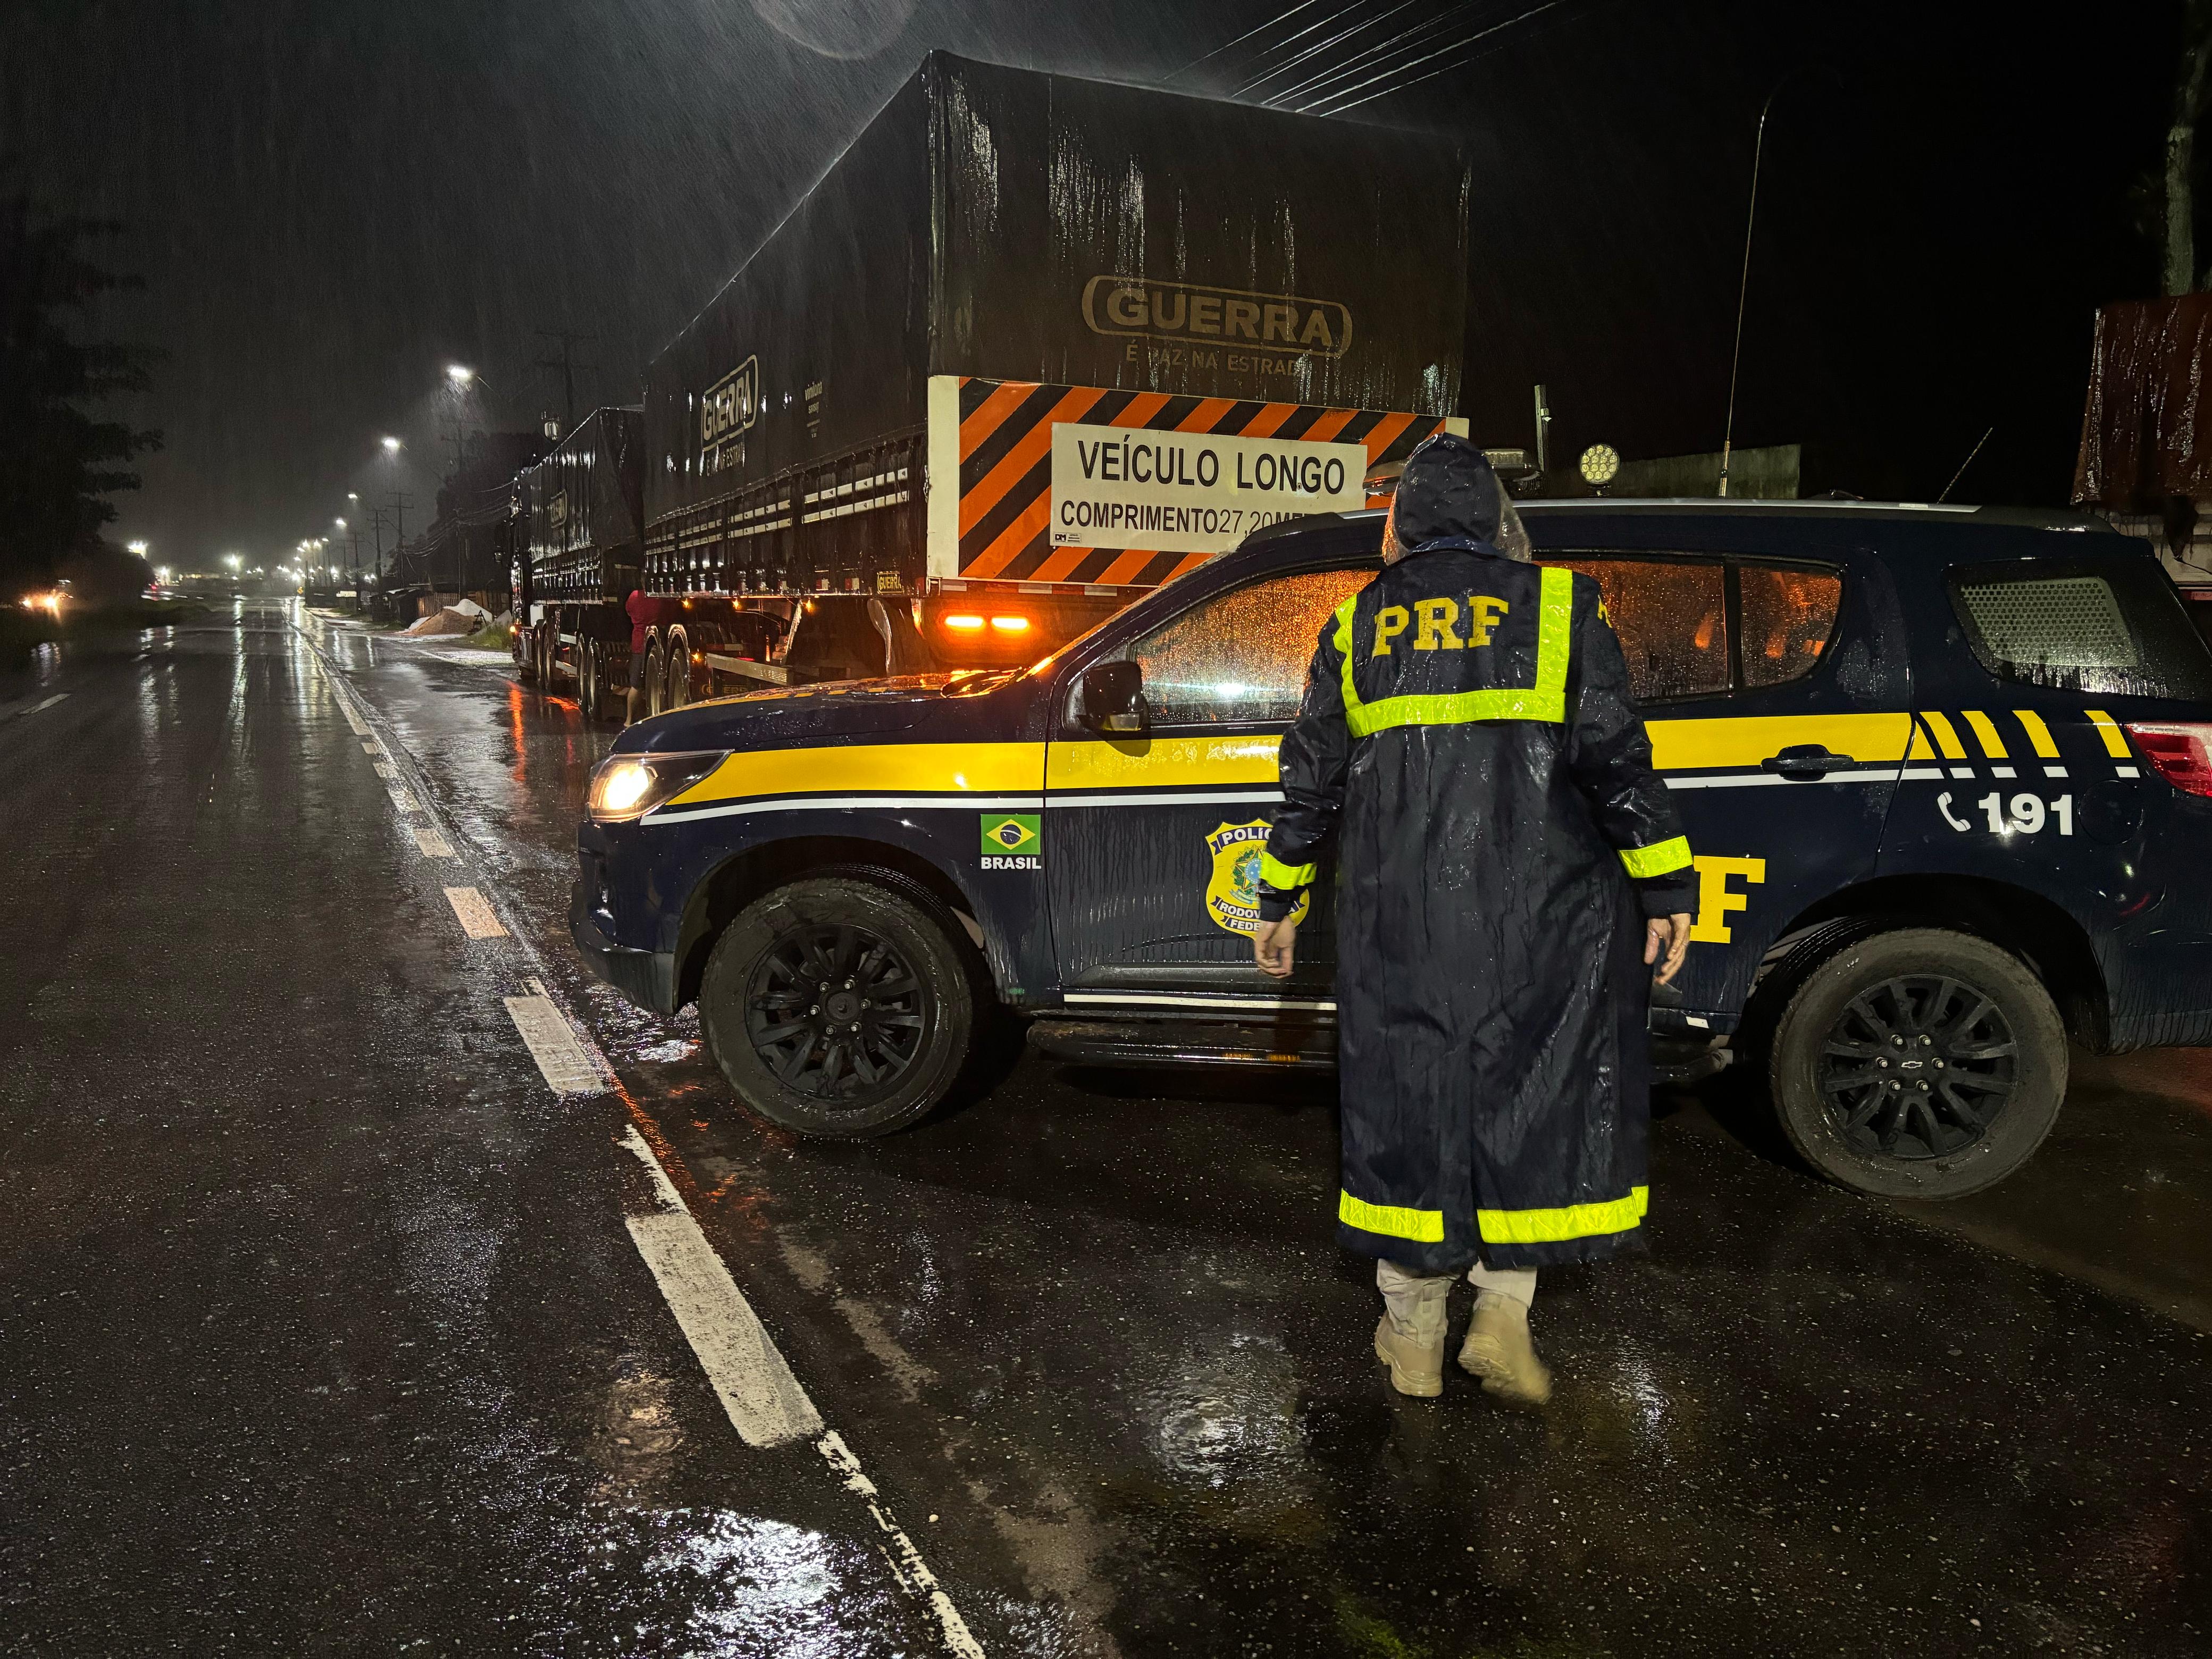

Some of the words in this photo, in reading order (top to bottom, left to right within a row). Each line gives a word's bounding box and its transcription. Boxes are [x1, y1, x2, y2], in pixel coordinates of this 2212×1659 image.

[1107, 288, 1332, 347] GUERRA
[1126, 340, 1138, 362] É
[1149, 348, 1183, 366] PAZ
[1192, 350, 1217, 370] NA
[1227, 355, 1309, 376] ESTRAD
[703, 370, 752, 441] GUERRA
[1078, 434, 1219, 487] VEÍCULO
[1237, 452, 1345, 495] LONGO
[879, 576, 902, 590] GUERRA
[1372, 596, 1509, 657] PRF
[1978, 792, 2073, 836] 191
[981, 857, 1042, 870] BRASIL
[1219, 902, 1261, 919] RODOV
[1230, 920, 1260, 932] FEDE
